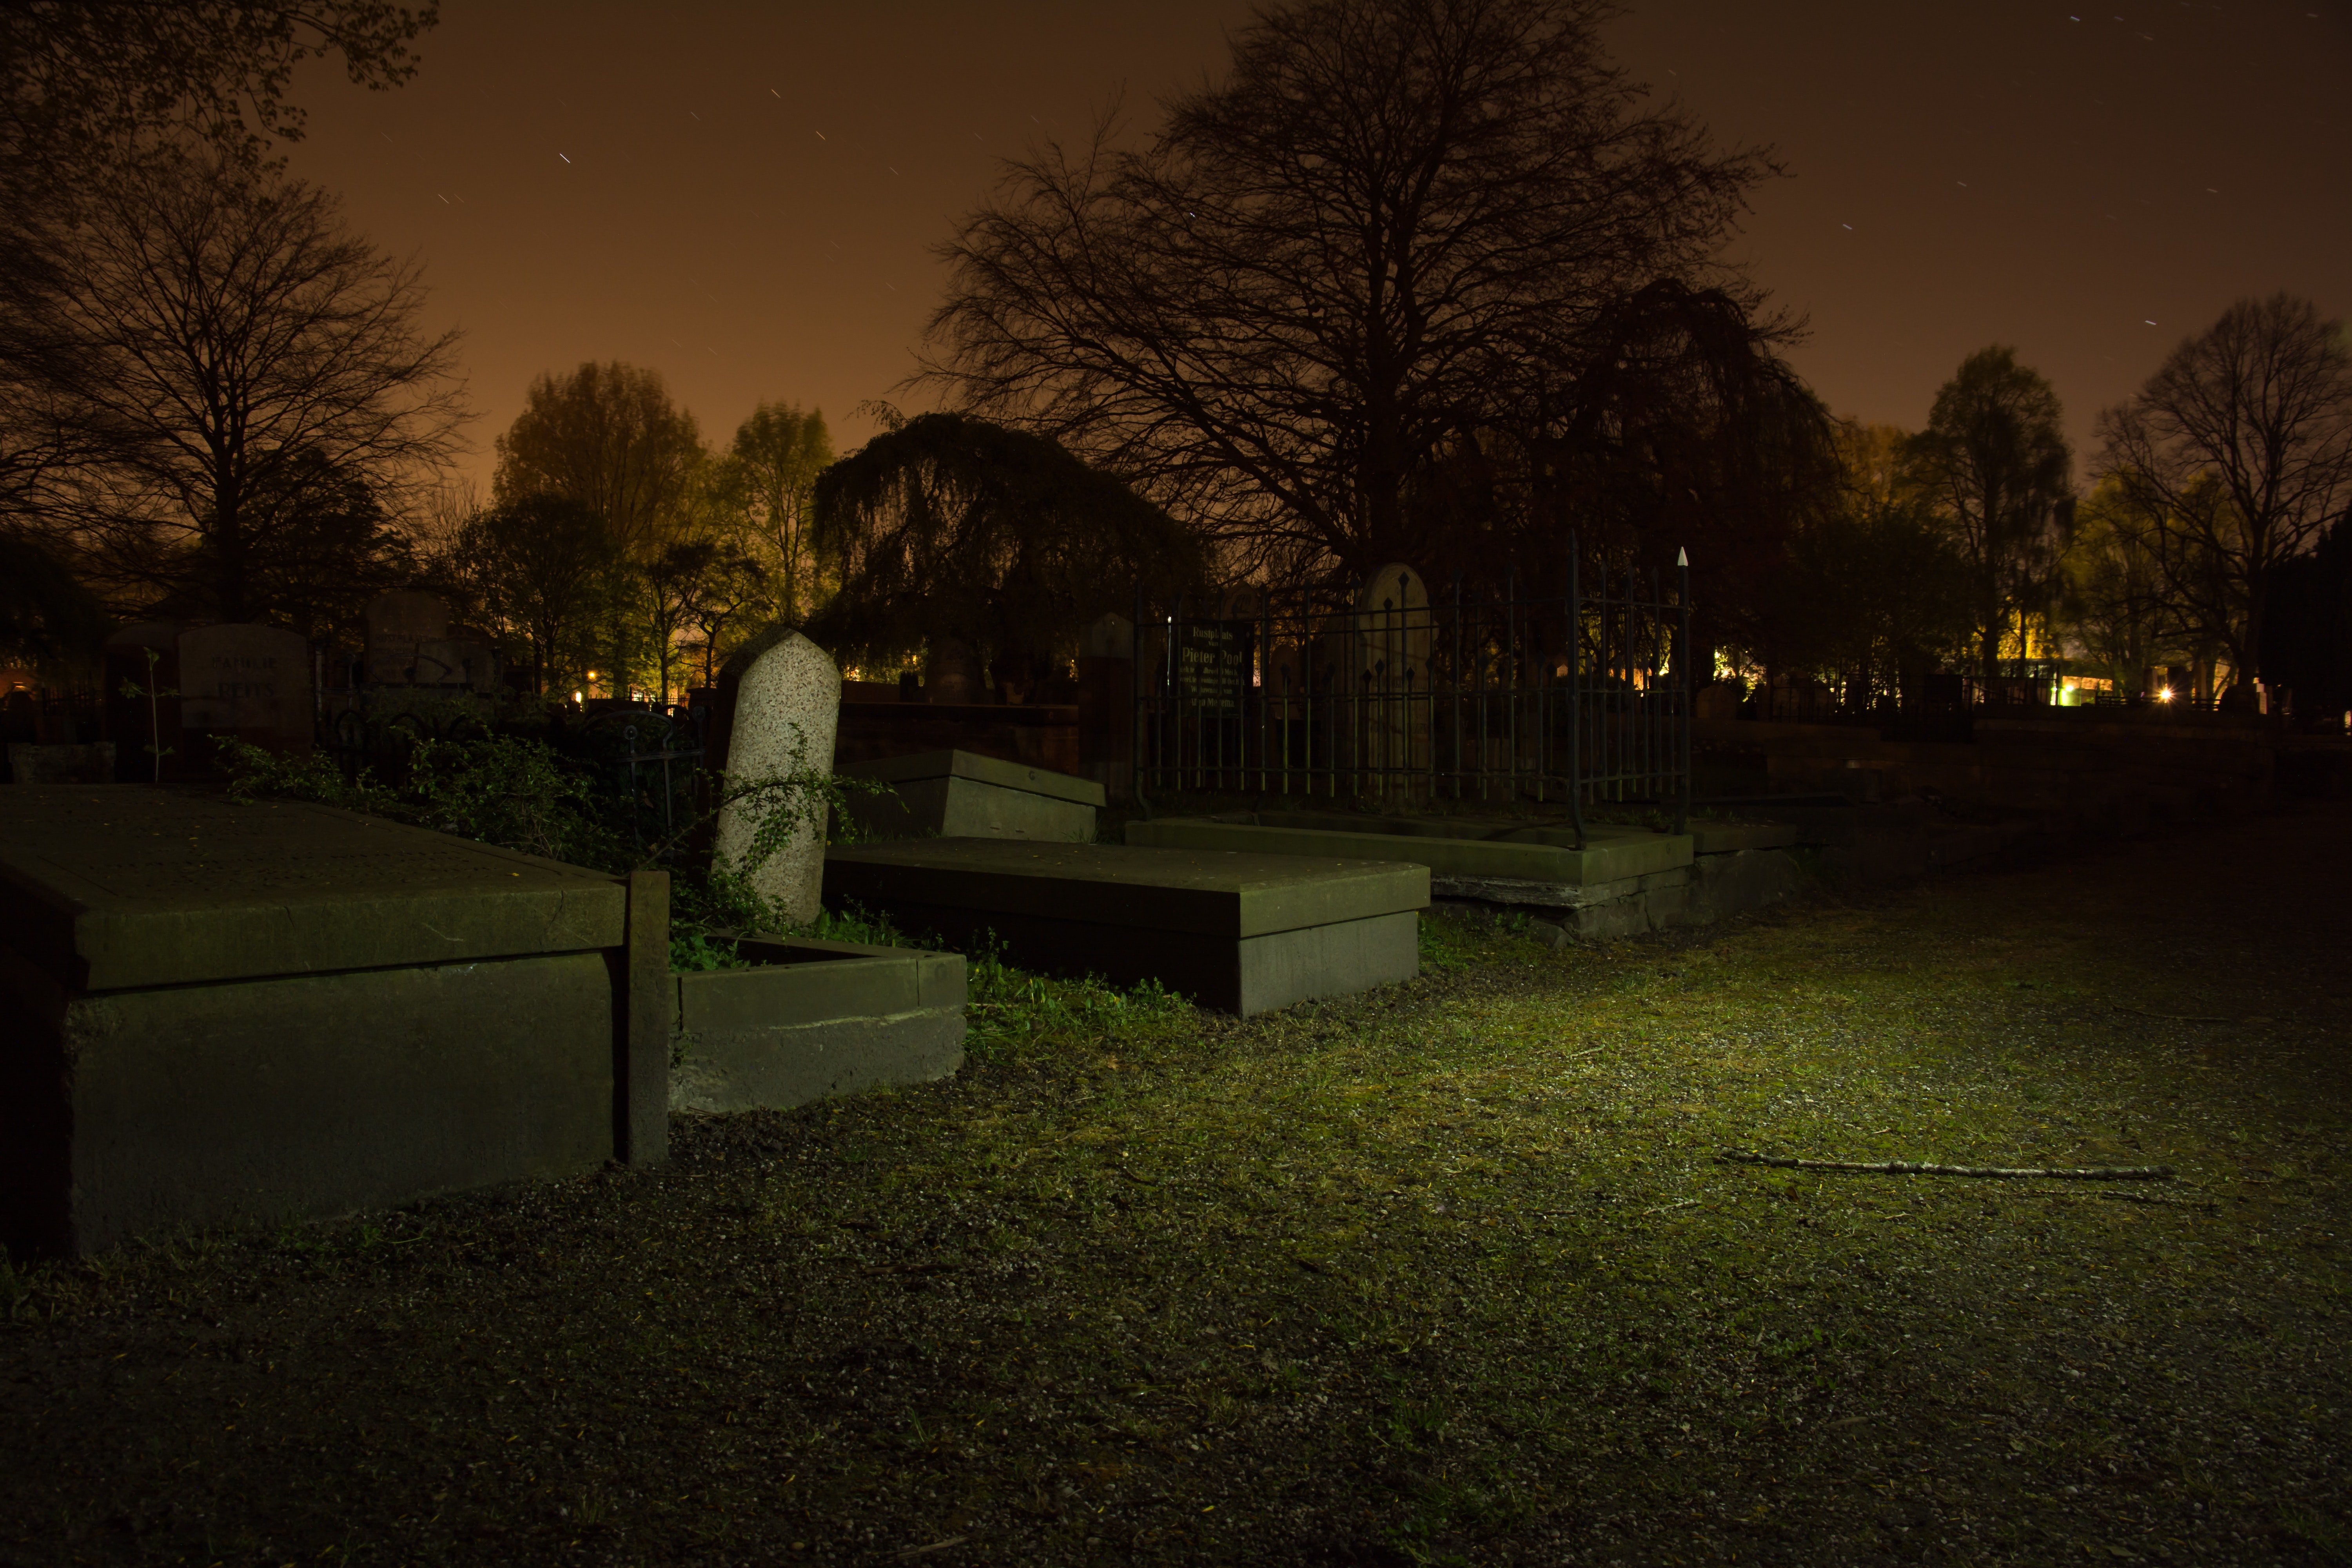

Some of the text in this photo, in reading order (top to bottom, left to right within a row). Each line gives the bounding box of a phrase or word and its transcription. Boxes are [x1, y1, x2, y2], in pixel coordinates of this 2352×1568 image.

[1193, 626, 1233, 640] Rustplats
[1182, 647, 1216, 664] Pieter
[212, 657, 277, 669] FAMILIE
[218, 682, 274, 698] REITS
[1188, 698, 1205, 706] Ana
